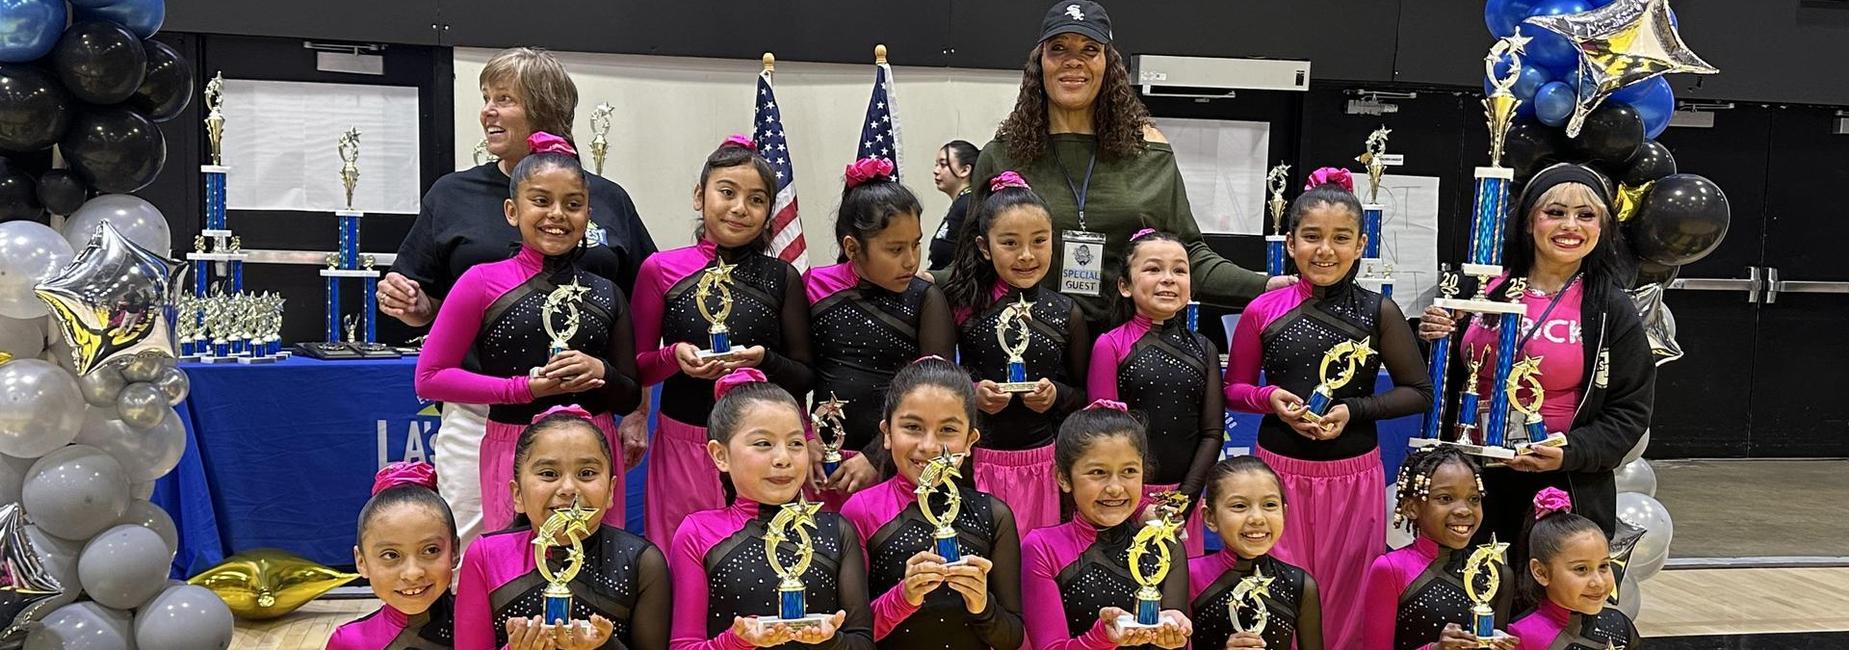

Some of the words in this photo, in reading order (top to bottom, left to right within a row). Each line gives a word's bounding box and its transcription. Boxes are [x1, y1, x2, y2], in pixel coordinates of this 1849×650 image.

[1063, 269, 1100, 280] SPECIAL
[1065, 280, 1096, 290] GUEST
[1439, 272, 1459, 288] 20
[1509, 276, 1527, 291] 25
